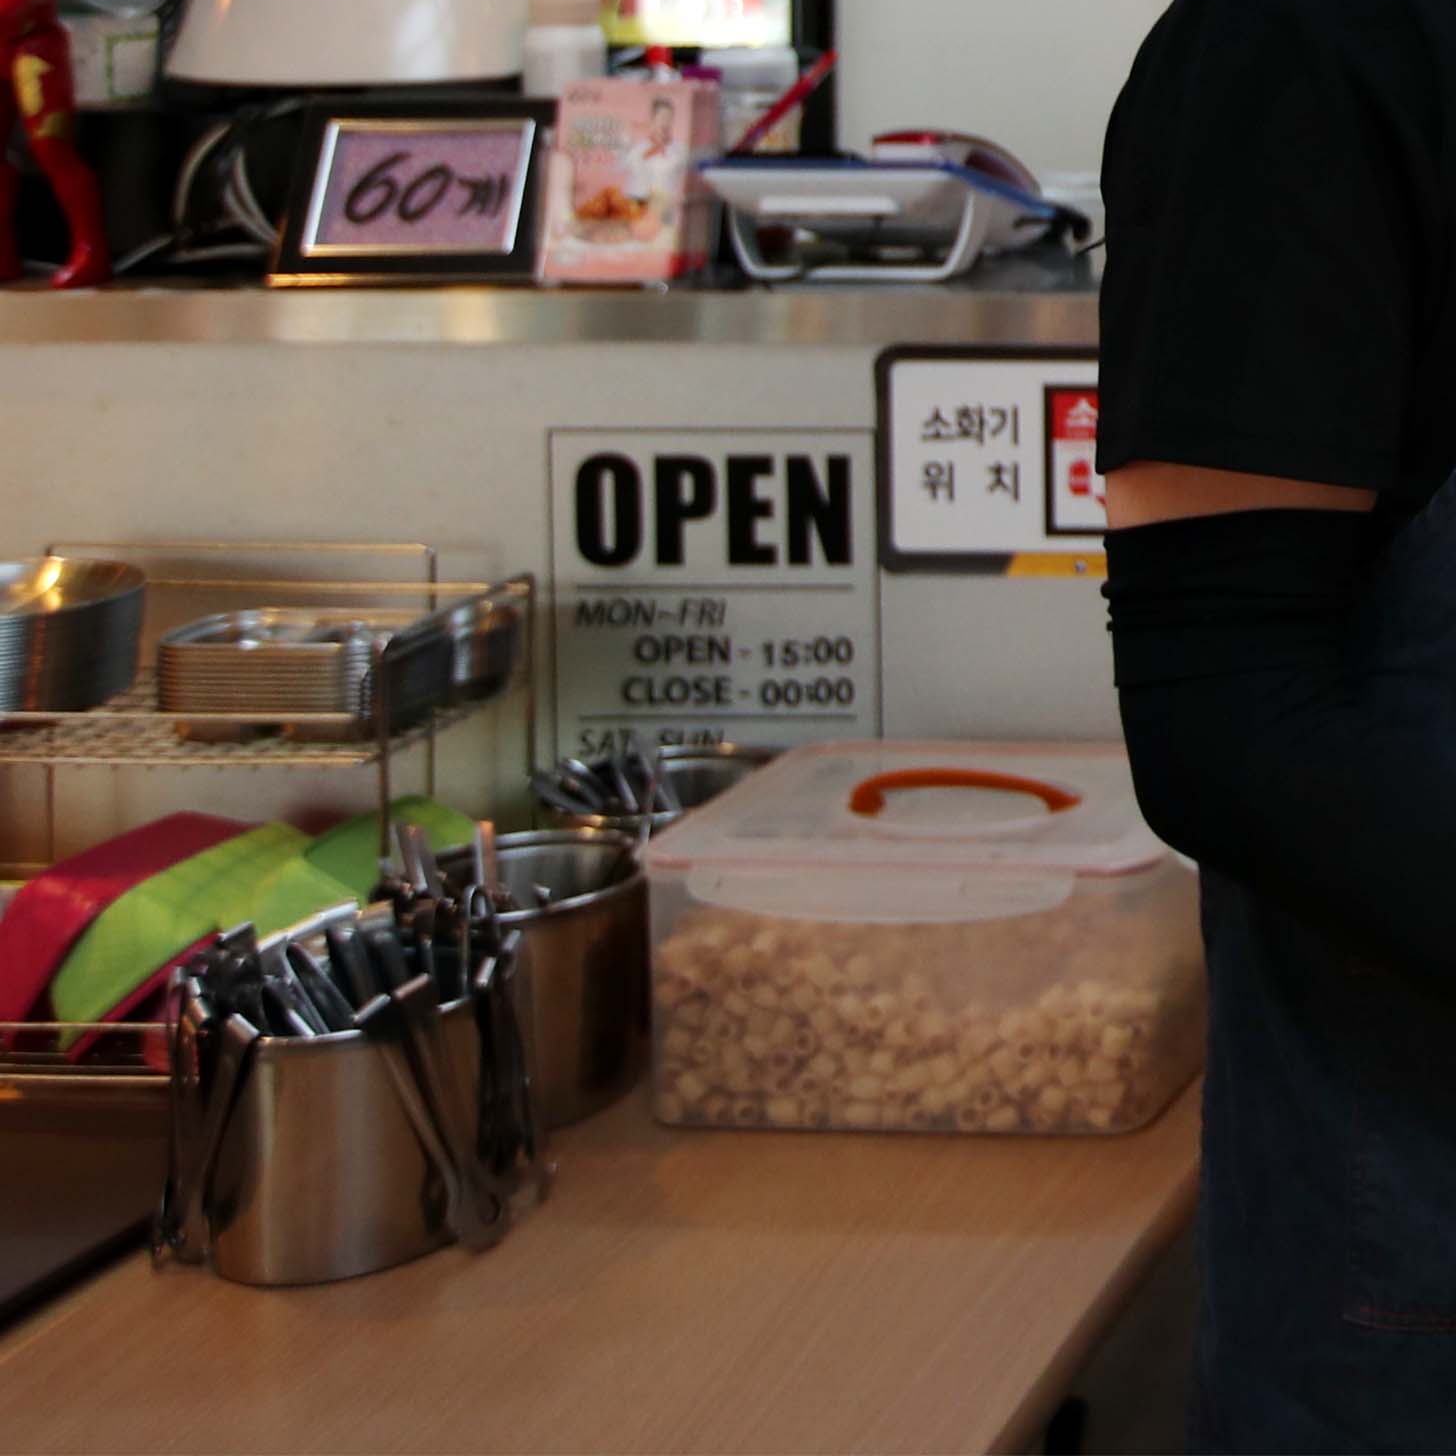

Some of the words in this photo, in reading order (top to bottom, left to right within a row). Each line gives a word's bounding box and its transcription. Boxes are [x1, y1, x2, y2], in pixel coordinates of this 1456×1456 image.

[344, 151, 510, 226] 60계
[921, 405, 1019, 444] 소화기
[921, 461, 955, 501] 위
[988, 462, 1019, 502] 치
[575, 452, 854, 568] OPEN
[633, 634, 733, 665] OPEN
[761, 636, 855, 668] 15:00
[620, 674, 733, 706] CLOSE
[760, 677, 857, 708] 00:00
